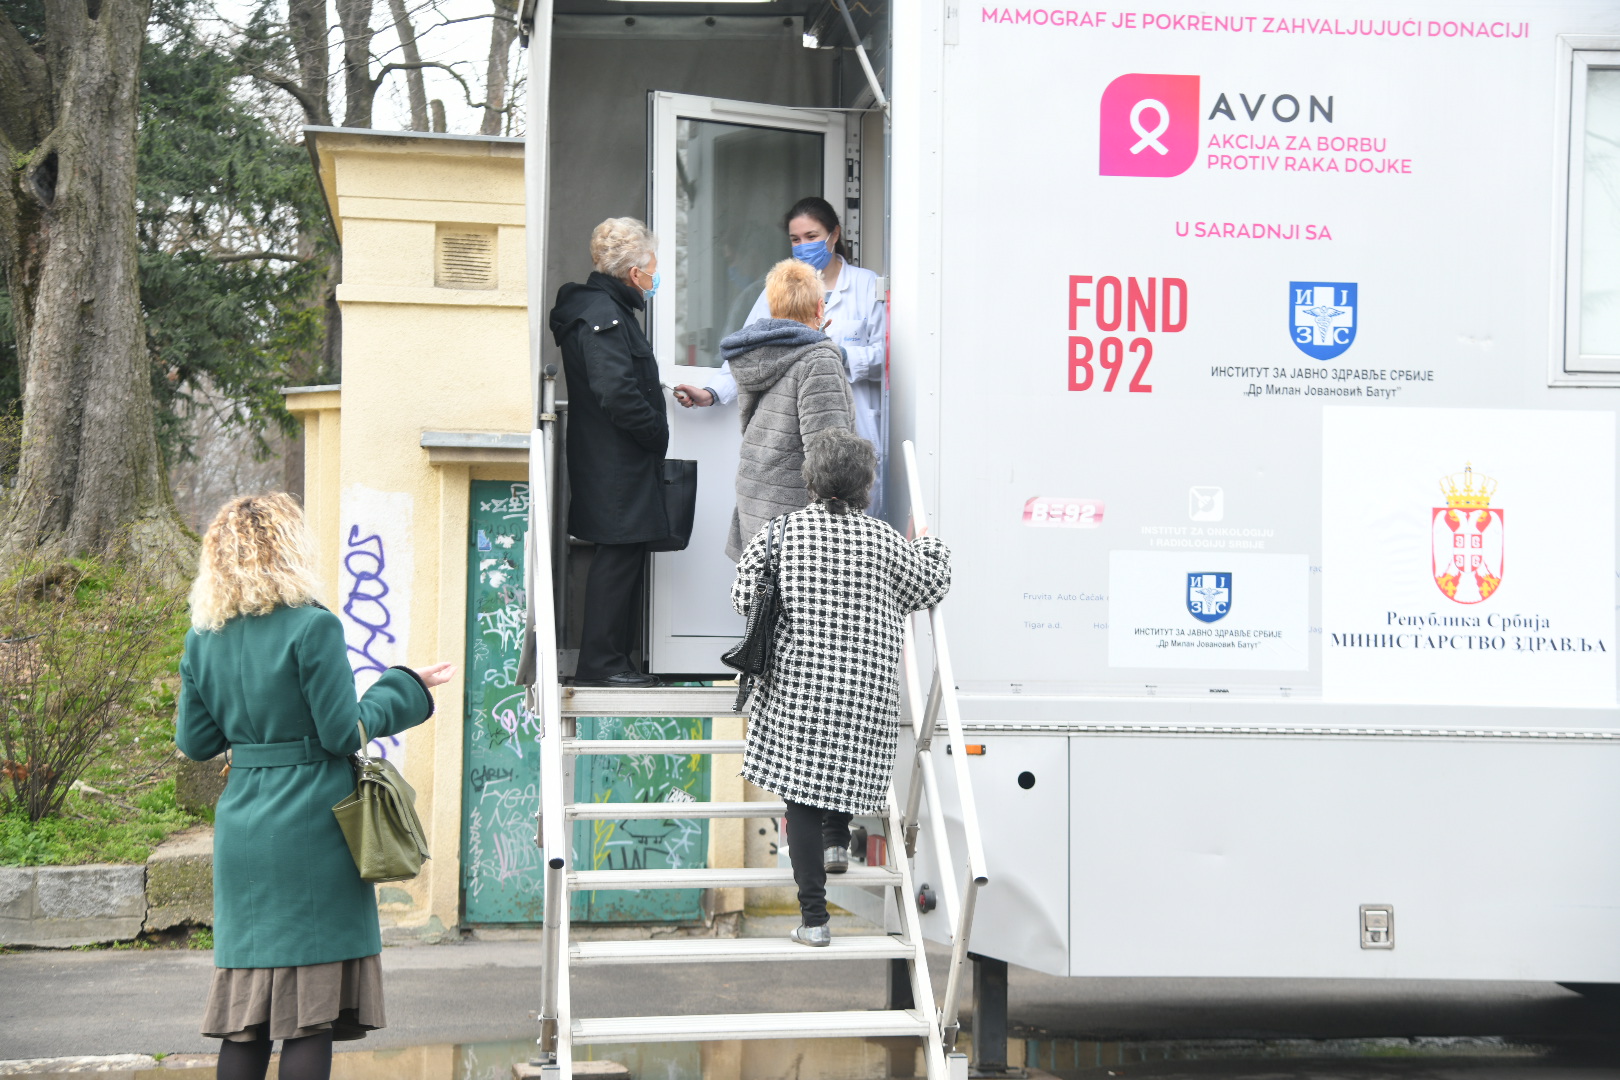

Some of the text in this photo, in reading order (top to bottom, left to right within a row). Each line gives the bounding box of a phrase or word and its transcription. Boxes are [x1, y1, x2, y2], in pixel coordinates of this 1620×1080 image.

[982, 7, 1530, 38] MAMOGRAF JE POKRENUT ZAHVALJUJUĆI DONACIJI
[1208, 92, 1334, 123] AVON
[1207, 134, 1387, 153] AKCIJA ZA BORBU
[1207, 154, 1412, 174] PROTIV RAKA DOJKE
[1175, 221, 1333, 241] U SARADNJI SA
[1068, 275, 1188, 333] FOND
[1295, 289, 1313, 305] И
[1333, 327, 1350, 345] С
[1068, 336, 1153, 393] B92
[1211, 366, 1434, 382] ИНСТИТУТ ЗА ЈАВНО ЗДРАВЉЕ СРБИЈЕ
[1265, 384, 1301, 396] Милан
[1303, 385, 1363, 397] Јовановић
[1141, 526, 1275, 537] INSTITUT ZA ONKOLOGIJU
[1156, 538, 1226, 548] RADIOLOGIJU
[1228, 540, 1265, 549] SRBIJE
[1023, 592, 1052, 601] Fruvita
[1057, 593, 1077, 601] Auto
[1024, 621, 1045, 630] Tigar
[1093, 621, 1109, 630] Hol
[1386, 611, 1550, 632] Република Србија
[1134, 627, 1283, 639] ИНСТИТУТ ЗА ЈАВНО ЗДРАВЉЕ СРБИЈЕ
[1171, 640, 1195, 648] Милан
[1196, 640, 1236, 649] Јовановић
[1331, 633, 1607, 653] МИНИСТАРСТВО ЗДРАВЉА
